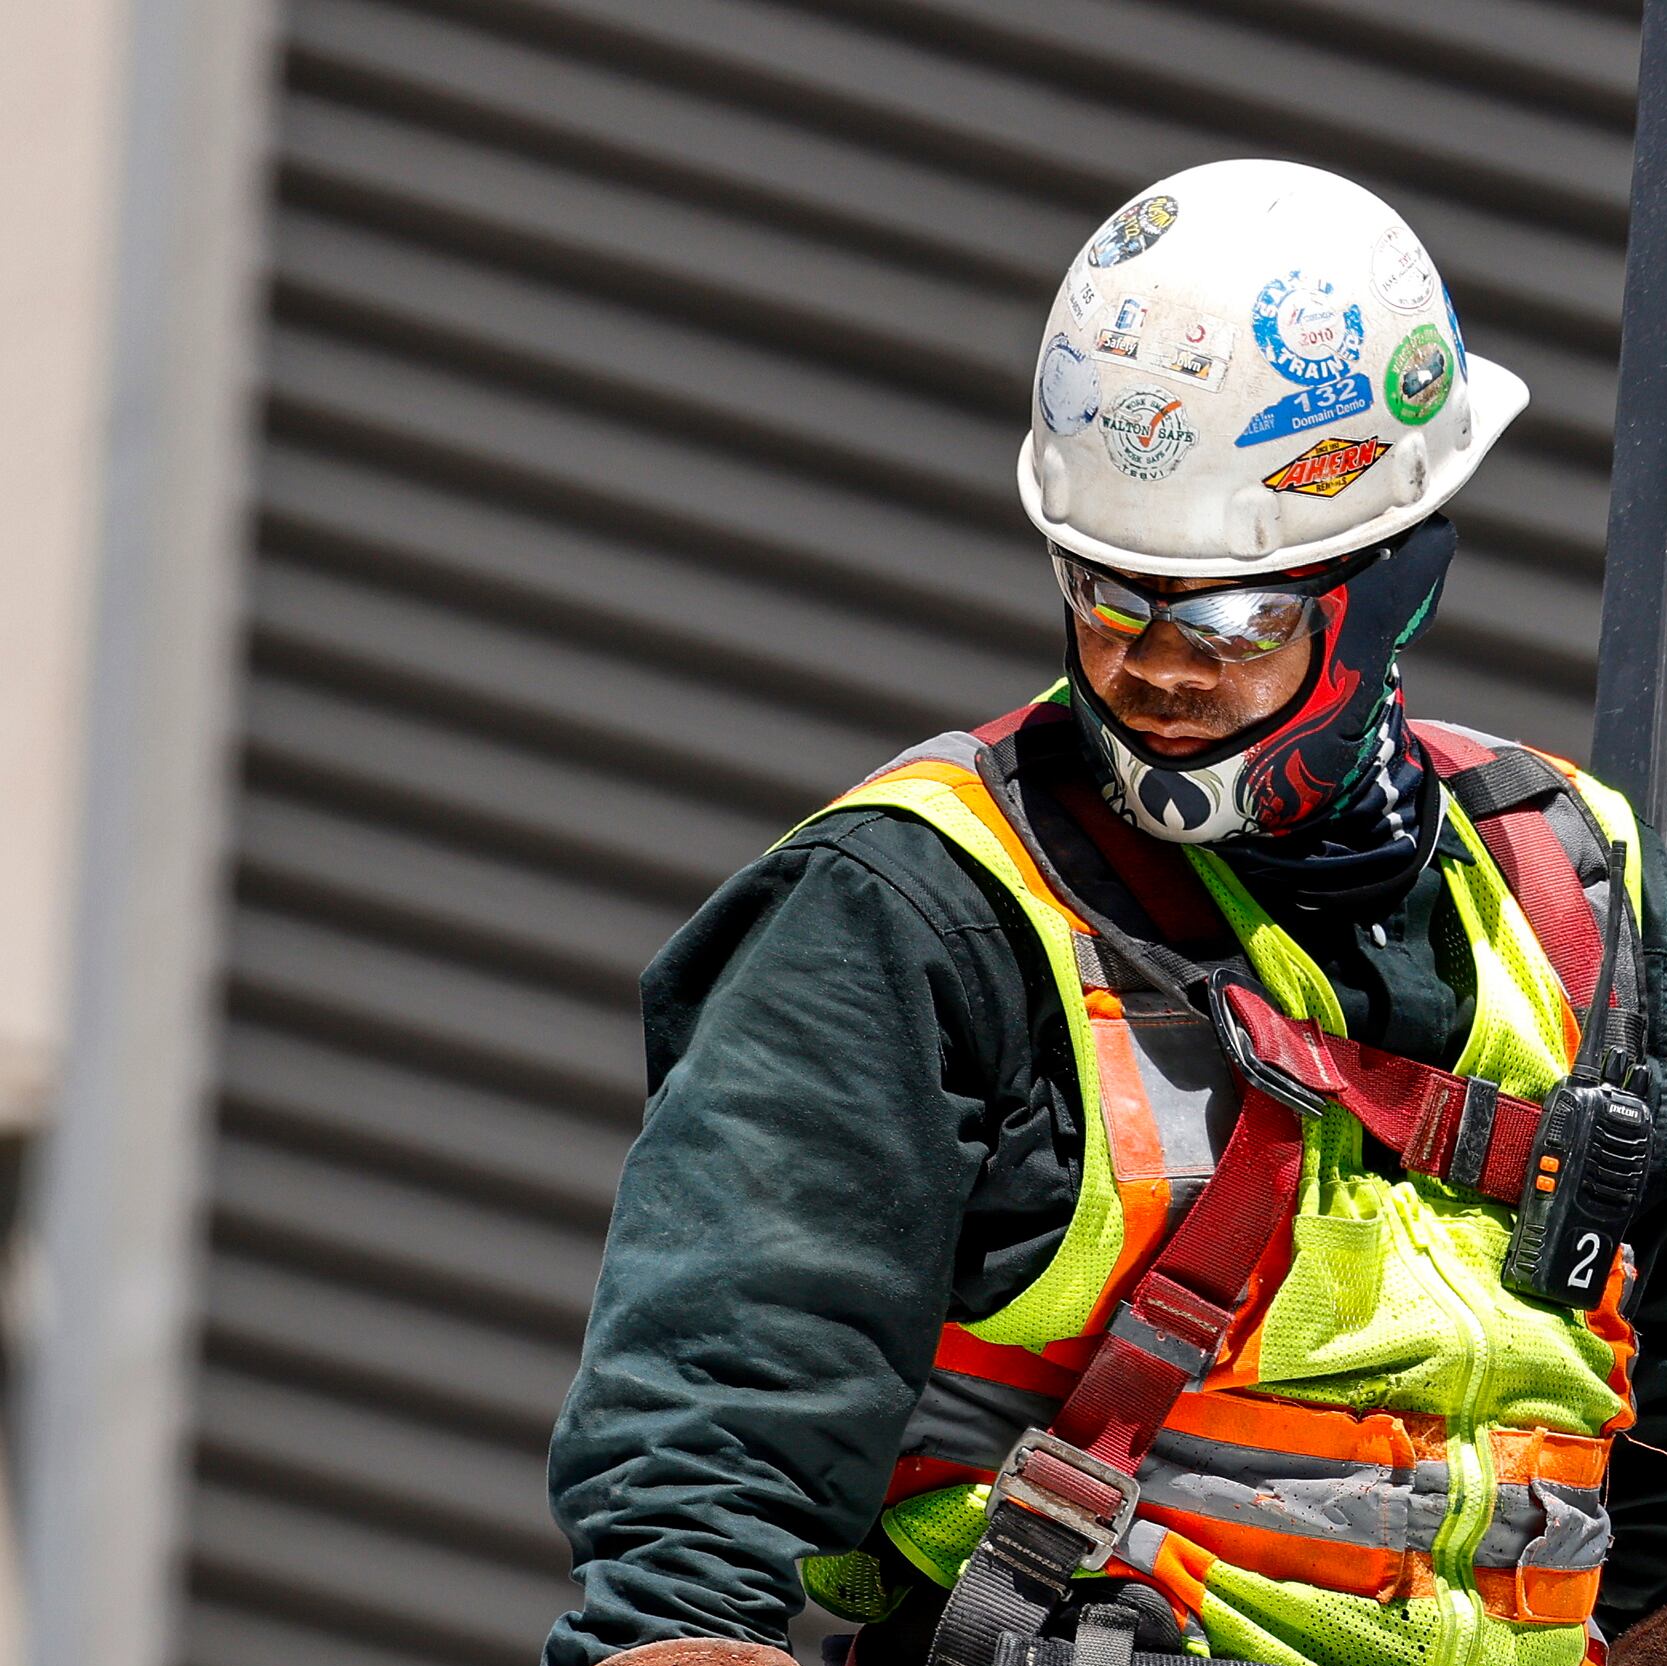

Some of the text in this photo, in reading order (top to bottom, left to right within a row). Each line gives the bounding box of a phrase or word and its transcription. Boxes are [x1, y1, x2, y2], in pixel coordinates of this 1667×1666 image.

[1080, 282, 1095, 305] 755
[1105, 335, 1137, 355] Safety
[1294, 379, 1358, 412] 132
[1102, 417, 1194, 442] WALTON SAFE
[1292, 409, 1335, 430] Domain
[1335, 398, 1365, 416] Demo
[1276, 439, 1377, 491] AHERN
[1567, 1232, 1600, 1289] 2
